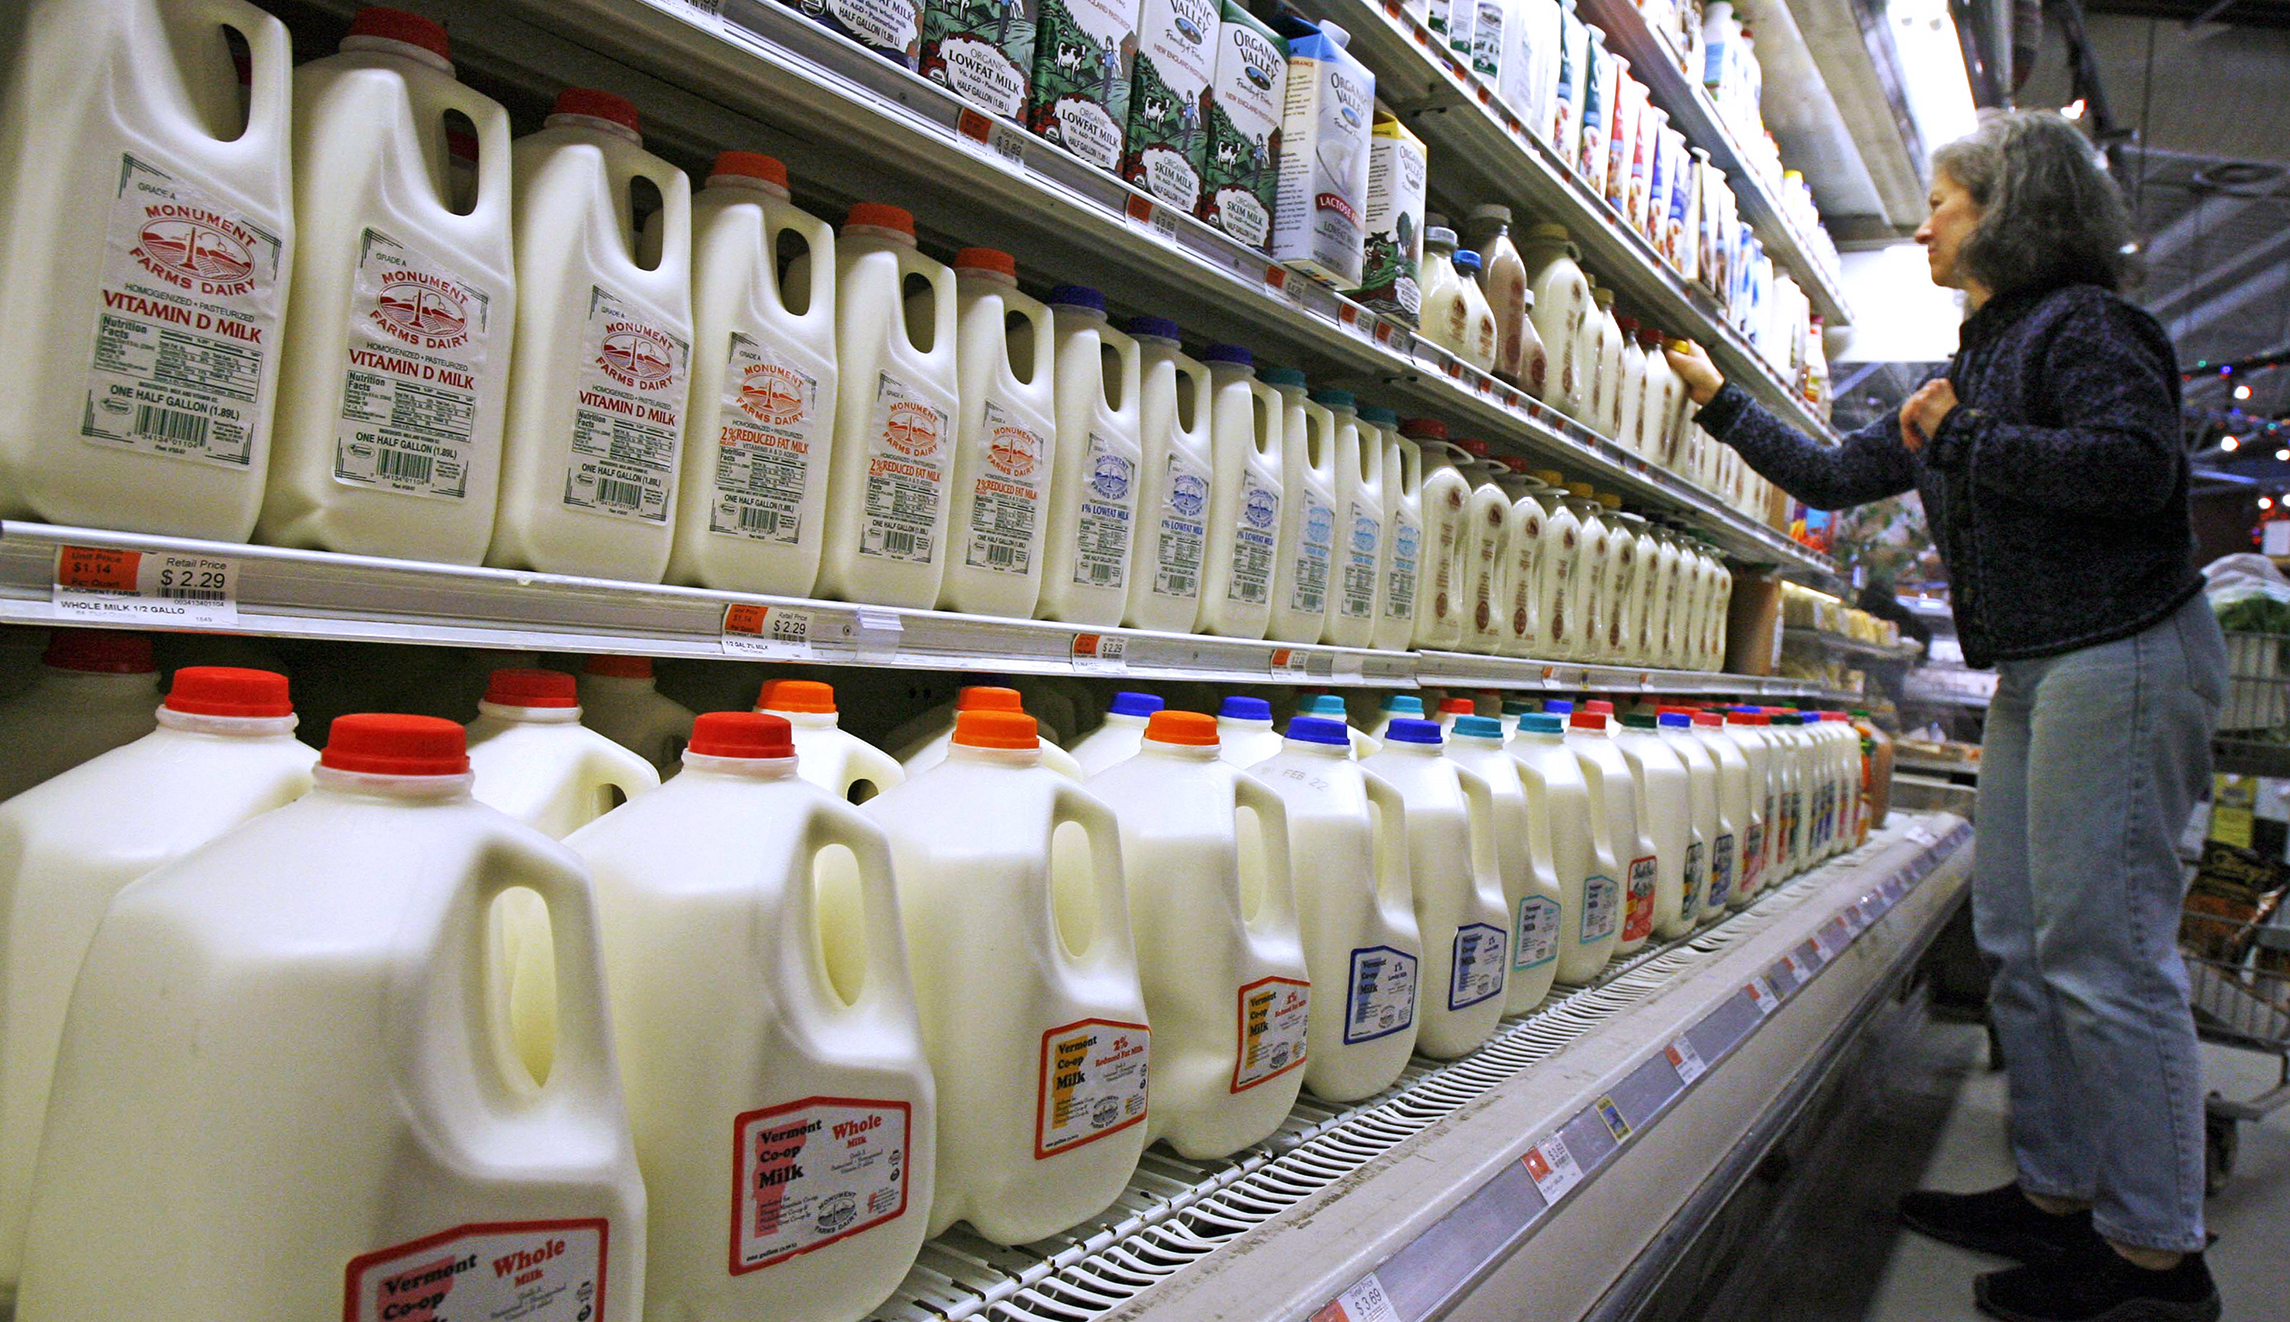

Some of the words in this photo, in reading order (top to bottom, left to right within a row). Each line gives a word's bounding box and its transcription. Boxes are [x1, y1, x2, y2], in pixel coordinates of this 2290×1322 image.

[839, 7, 855, 21] HALF
[856, 16, 881, 36] GALLON
[892, 4, 912, 22] MILK
[1171, 0, 1208, 34] VALLEY
[970, 48, 1006, 74] ORGANIC
[1234, 30, 1281, 72] ORGANIC
[950, 49, 994, 79] LOWFAT
[995, 71, 1019, 95] MILK
[1240, 49, 1276, 81] VALLEY
[957, 80, 973, 92] HALF
[973, 85, 993, 103] GALLON
[1330, 72, 1367, 103] ORGANIC
[1336, 90, 1364, 118] VALLEY
[1061, 109, 1097, 136] LOWFAT
[1099, 126, 1119, 148] MILK
[1079, 107, 1108, 130] ORGANIC
[1068, 137, 1081, 149] HALF
[1154, 161, 1176, 178] SKIM
[1176, 173, 1193, 190] MILK
[1164, 155, 1189, 175] ORGANIC
[138, 182, 167, 197] GRADE
[169, 192, 176, 200] A
[1227, 201, 1246, 216] SKIM
[1247, 210, 1263, 226] MILK
[144, 204, 257, 247] MONUMENT
[376, 252, 400, 266] GRADE
[130, 247, 192, 291] FARMS
[201, 277, 257, 299] DAIRY
[381, 271, 469, 305] MONUMENT
[124, 282, 192, 307] HOMOGENIZED
[199, 302, 255, 324] PASTEURIZED
[103, 289, 191, 326] VITAMIN
[196, 313, 211, 330] D
[216, 319, 263, 345] MILK
[103, 316, 147, 334] Nutrition
[102, 326, 129, 339] Facts
[369, 310, 420, 345] FARMS
[426, 332, 469, 350] DAIRY
[605, 322, 674, 351] MONUMENT
[366, 342, 420, 361] HOMOGENIZED
[425, 354, 469, 372] PASTEURIZED
[349, 348, 419, 378] VITAMIN
[423, 366, 435, 380] D
[439, 372, 475, 391] MILK
[349, 372, 385, 386] Nutrition
[595, 356, 634, 387] FARMS
[639, 375, 674, 391] DAIRY
[744, 364, 804, 389] MONUMENT
[348, 380, 371, 392] Facts
[592, 384, 634, 400] HOMOGENIZED
[110, 384, 133, 398] ONE
[136, 390, 163, 403] HALF
[166, 396, 208, 413] GALLON
[210, 405, 240, 421] (1.89L)
[579, 390, 632, 417] VITAMIN
[636, 406, 646, 418] D
[648, 410, 675, 427] MILK
[736, 397, 771, 423] FARMS
[774, 410, 804, 426] DAIRY
[890, 401, 939, 422] MONUMENT
[577, 418, 595, 429] Facts
[578, 410, 606, 424] Nutrition
[356, 432, 375, 443] ONE
[377, 435, 399, 448] HALF
[400, 440, 433, 454] GALLON
[721, 426, 737, 442] 2%
[736, 429, 775, 447] REDUCED
[777, 439, 789, 450] FAT
[791, 441, 809, 454] MILK
[882, 431, 911, 456] FARMS
[914, 443, 939, 457] DAIRY
[993, 426, 1036, 446] MONUMENT
[581, 463, 597, 474] ONE
[598, 466, 615, 478] HALF
[616, 470, 642, 483] GALLON
[870, 458, 883, 472] 2%
[882, 460, 914, 477] REDUCED
[915, 468, 926, 478] FAT
[927, 470, 941, 483] MILK
[987, 454, 1011, 476] FARMS
[1014, 464, 1036, 477] DAIRY
[1096, 455, 1129, 470] MONUMENT
[987, 481, 1014, 495] REDUCED
[1024, 489, 1038, 500] MILK
[1112, 488, 1128, 500] DAIRY
[724, 494, 738, 503] ONE
[739, 496, 754, 506] HALF
[755, 499, 778, 511] GALLON
[1093, 505, 1117, 518] LOWFAT
[872, 519, 884, 527] ONE
[884, 521, 896, 529] HALF
[166, 557, 196, 568] Retail
[200, 560, 227, 570] Price
[60, 601, 101, 611] WHOLE
[104, 603, 130, 611] MILK
[133, 605, 148, 613] 1/2
[151, 606, 185, 615] GALLO
[1282, 769, 1306, 780] FEB
[1250, 992, 1276, 1007] Vermont
[1361, 983, 1378, 994] Milk
[1250, 1022, 1269, 1037] Milk
[1058, 1036, 1097, 1054] Vermont
[1114, 1035, 1128, 1051] 2%
[1057, 1056, 1084, 1070] Co-op
[1096, 1053, 1121, 1067] Reduced
[1121, 1049, 1131, 1058] Fat
[1131, 1045, 1144, 1054] Milk
[1056, 1071, 1086, 1090] Milk
[760, 1119, 823, 1144] Vermont
[832, 1114, 882, 1140] Whole
[847, 1136, 867, 1149] Milk
[760, 1146, 800, 1163] Co-op
[759, 1164, 804, 1189] Milk
[818, 1191, 857, 1210] MONUMENT
[814, 1225, 836, 1235] FARMS
[838, 1212, 858, 1231] DAIRY
[492, 1239, 565, 1279] Whole
[385, 1254, 478, 1296] Vermont
[514, 1268, 544, 1289] Milk
[382, 1292, 446, 1320] Co-op
